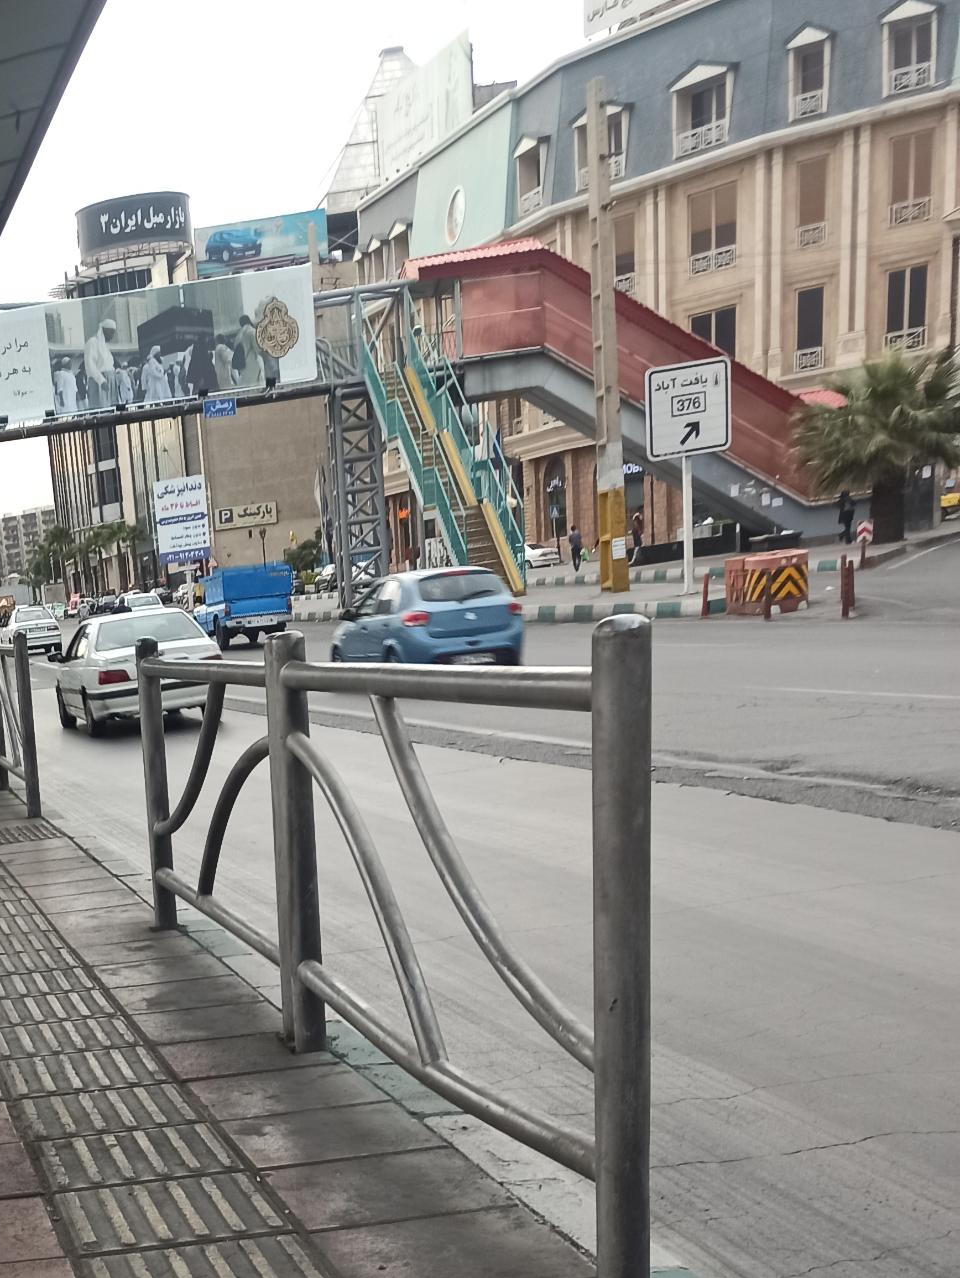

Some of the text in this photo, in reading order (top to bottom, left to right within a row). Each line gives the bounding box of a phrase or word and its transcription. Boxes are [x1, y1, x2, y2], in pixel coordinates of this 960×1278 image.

[100, 206, 185, 234] بازار مبل ایران ۳
[1, 342, 12, 355] در
[14, 338, 29, 352] مرا
[5, 366, 19, 380] هر
[21, 365, 32, 376] به
[654, 372, 708, 394] یافت آباد
[676, 396, 701, 412] 376
[221, 509, 232, 523] P
